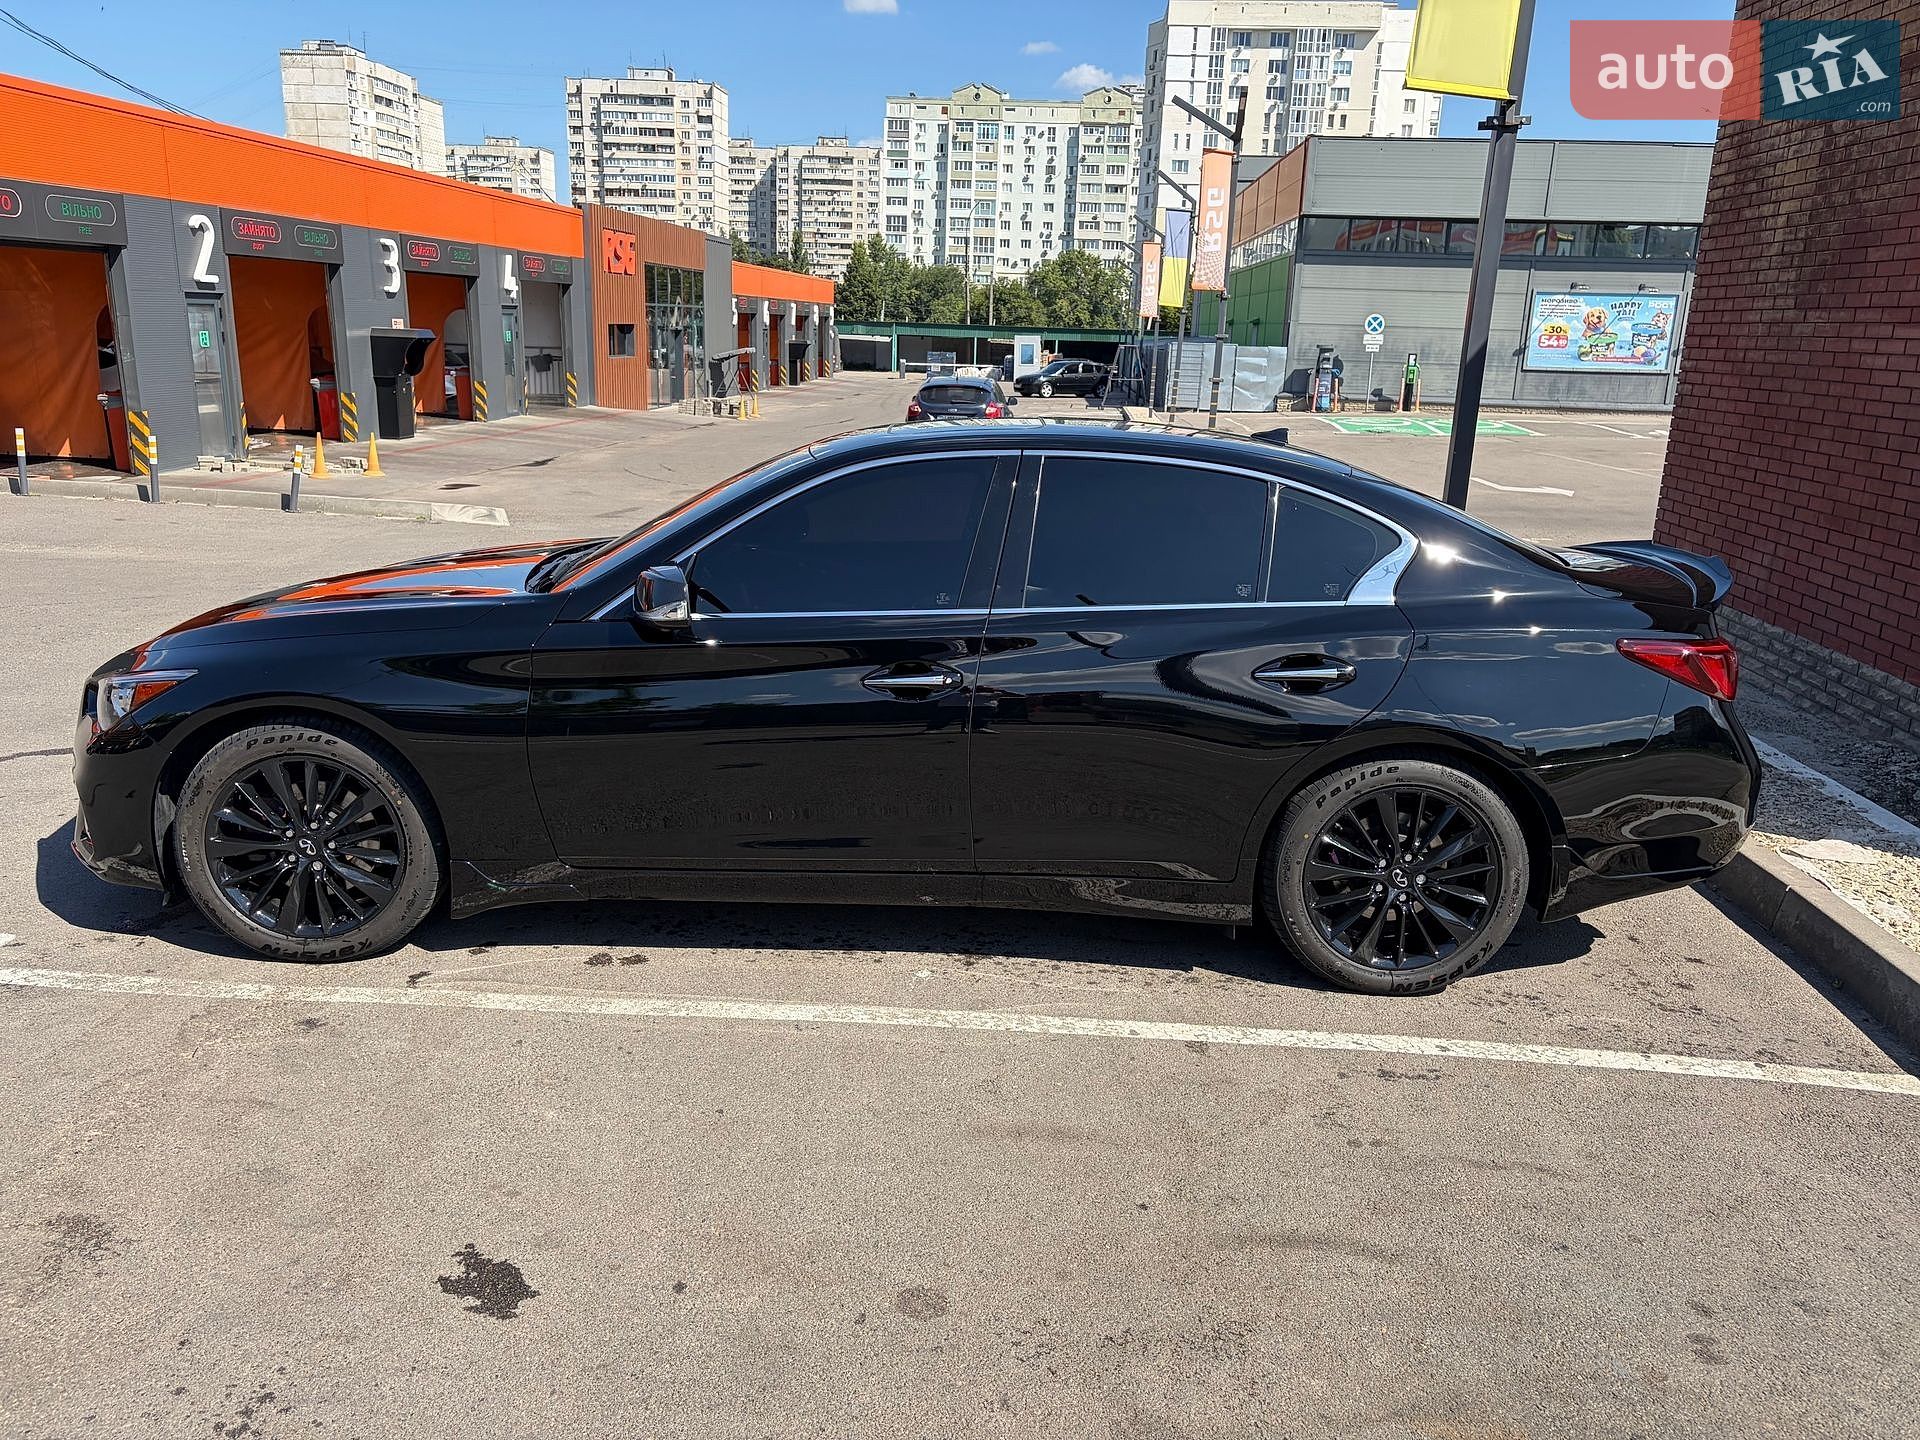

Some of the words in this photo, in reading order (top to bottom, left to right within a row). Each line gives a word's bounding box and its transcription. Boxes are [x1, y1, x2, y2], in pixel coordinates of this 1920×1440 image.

[61, 202, 102, 220] ВІЛЬНО
[238, 220, 276, 238] ЗАЙНЯТО
[187, 214, 220, 284] 2
[379, 238, 400, 292] 3
[503, 254, 518, 299] 4
